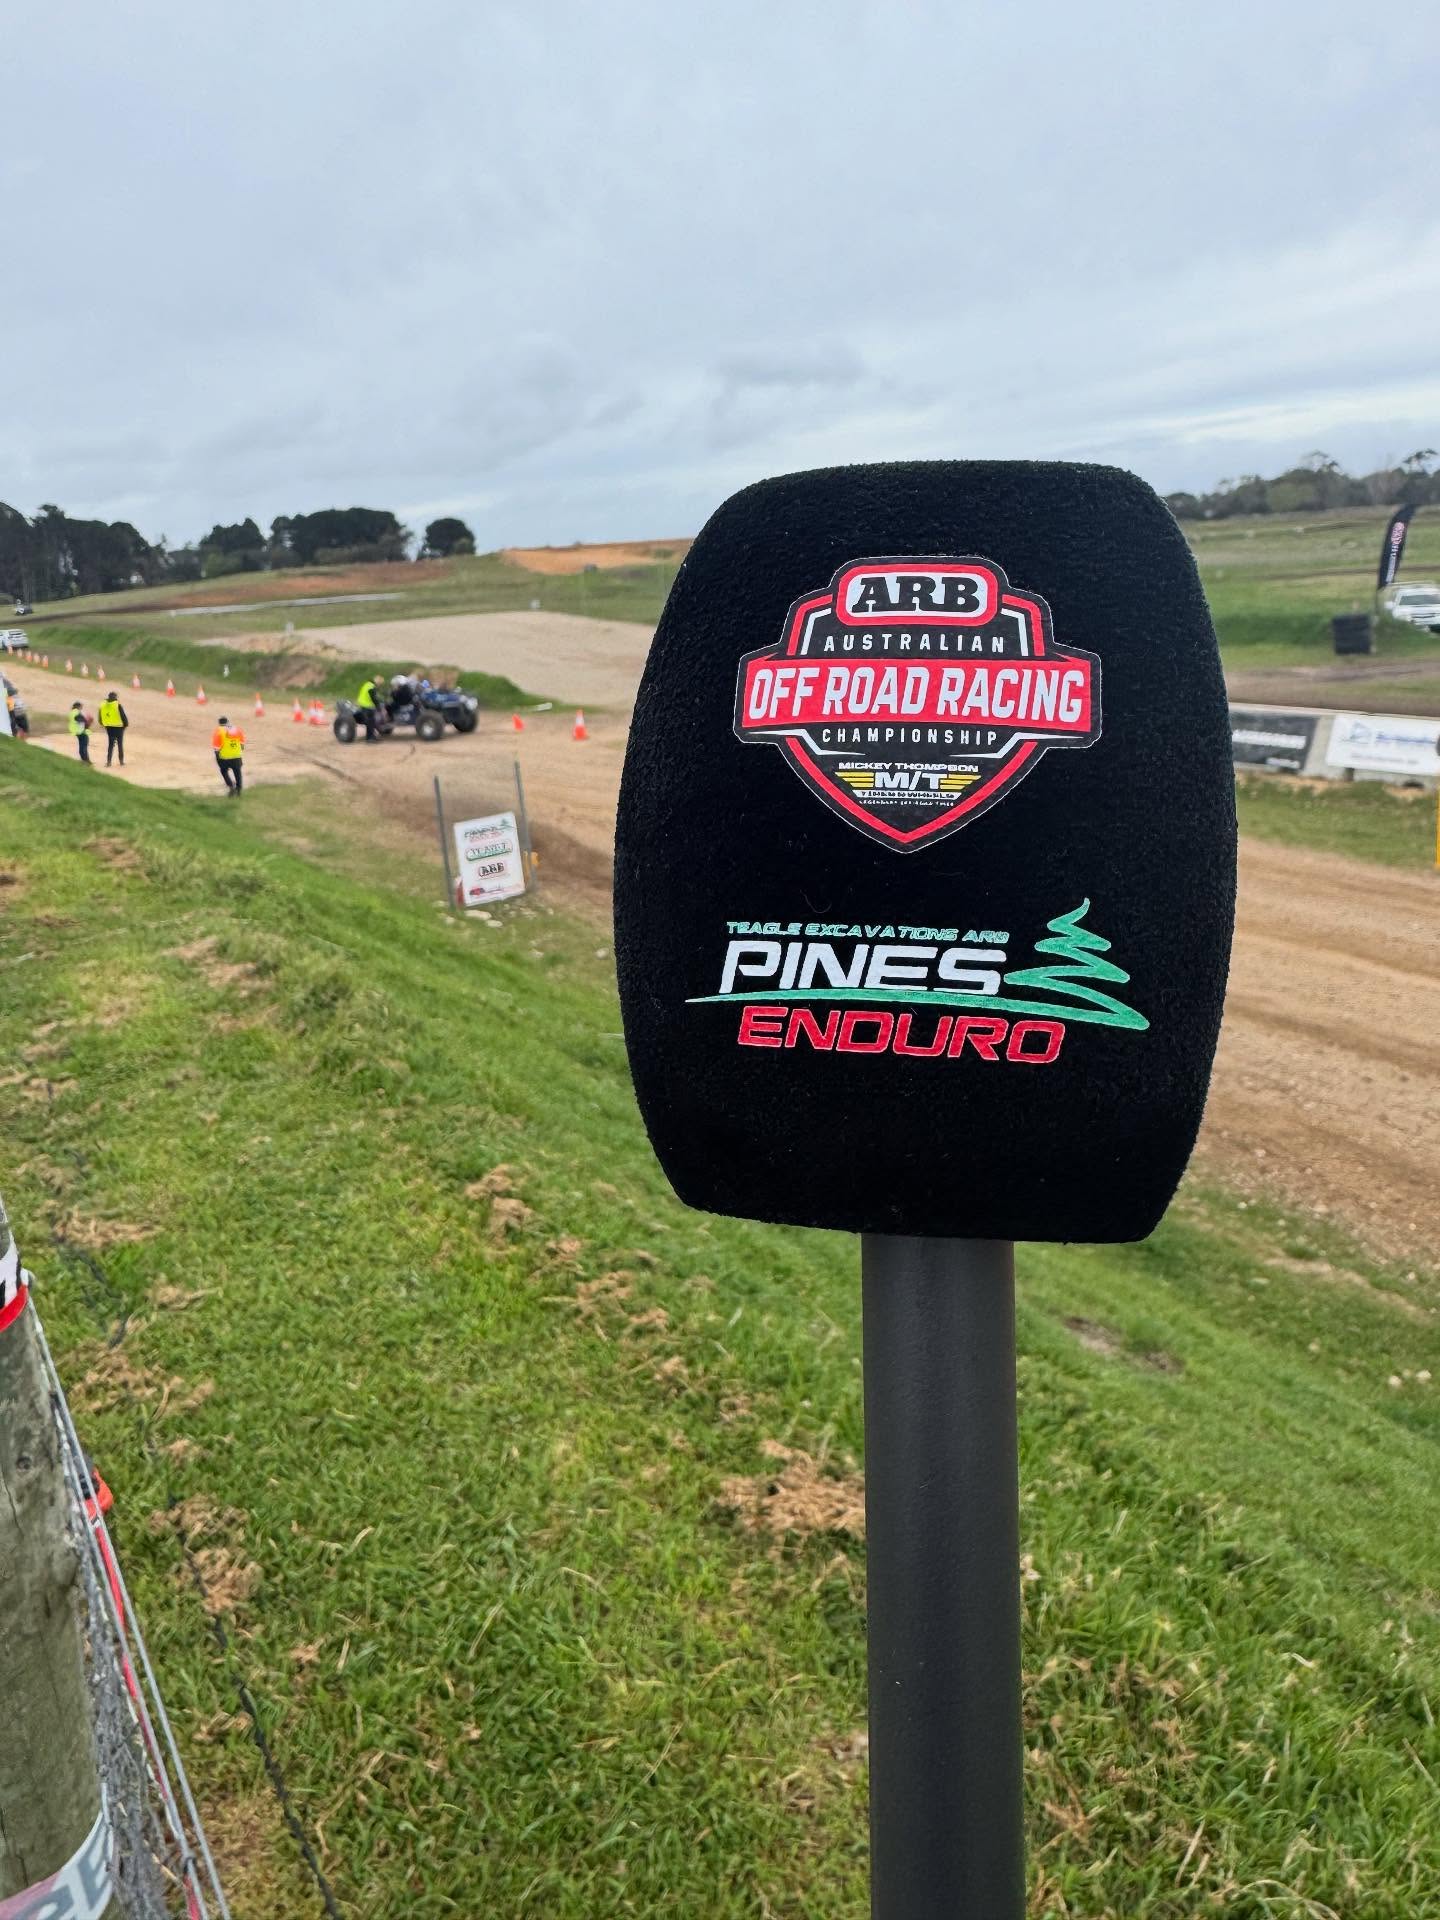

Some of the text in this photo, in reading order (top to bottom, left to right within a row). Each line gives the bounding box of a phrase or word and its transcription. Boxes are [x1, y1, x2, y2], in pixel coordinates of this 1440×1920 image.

[851, 576, 980, 613] ARB
[823, 633, 1005, 653] AUSTRALIAN
[748, 666, 1086, 723] OFF ROAD RACING
[822, 728, 998, 746] CHAMPIONSHIP
[838, 762, 979, 772] MICKEY THOMPSON
[875, 771, 948, 790] M/T
[726, 921, 1011, 944] TEAGLE EXCAVATIONS ARB
[718, 940, 1008, 995] PINES
[737, 1005, 1067, 1063] ENDURO
